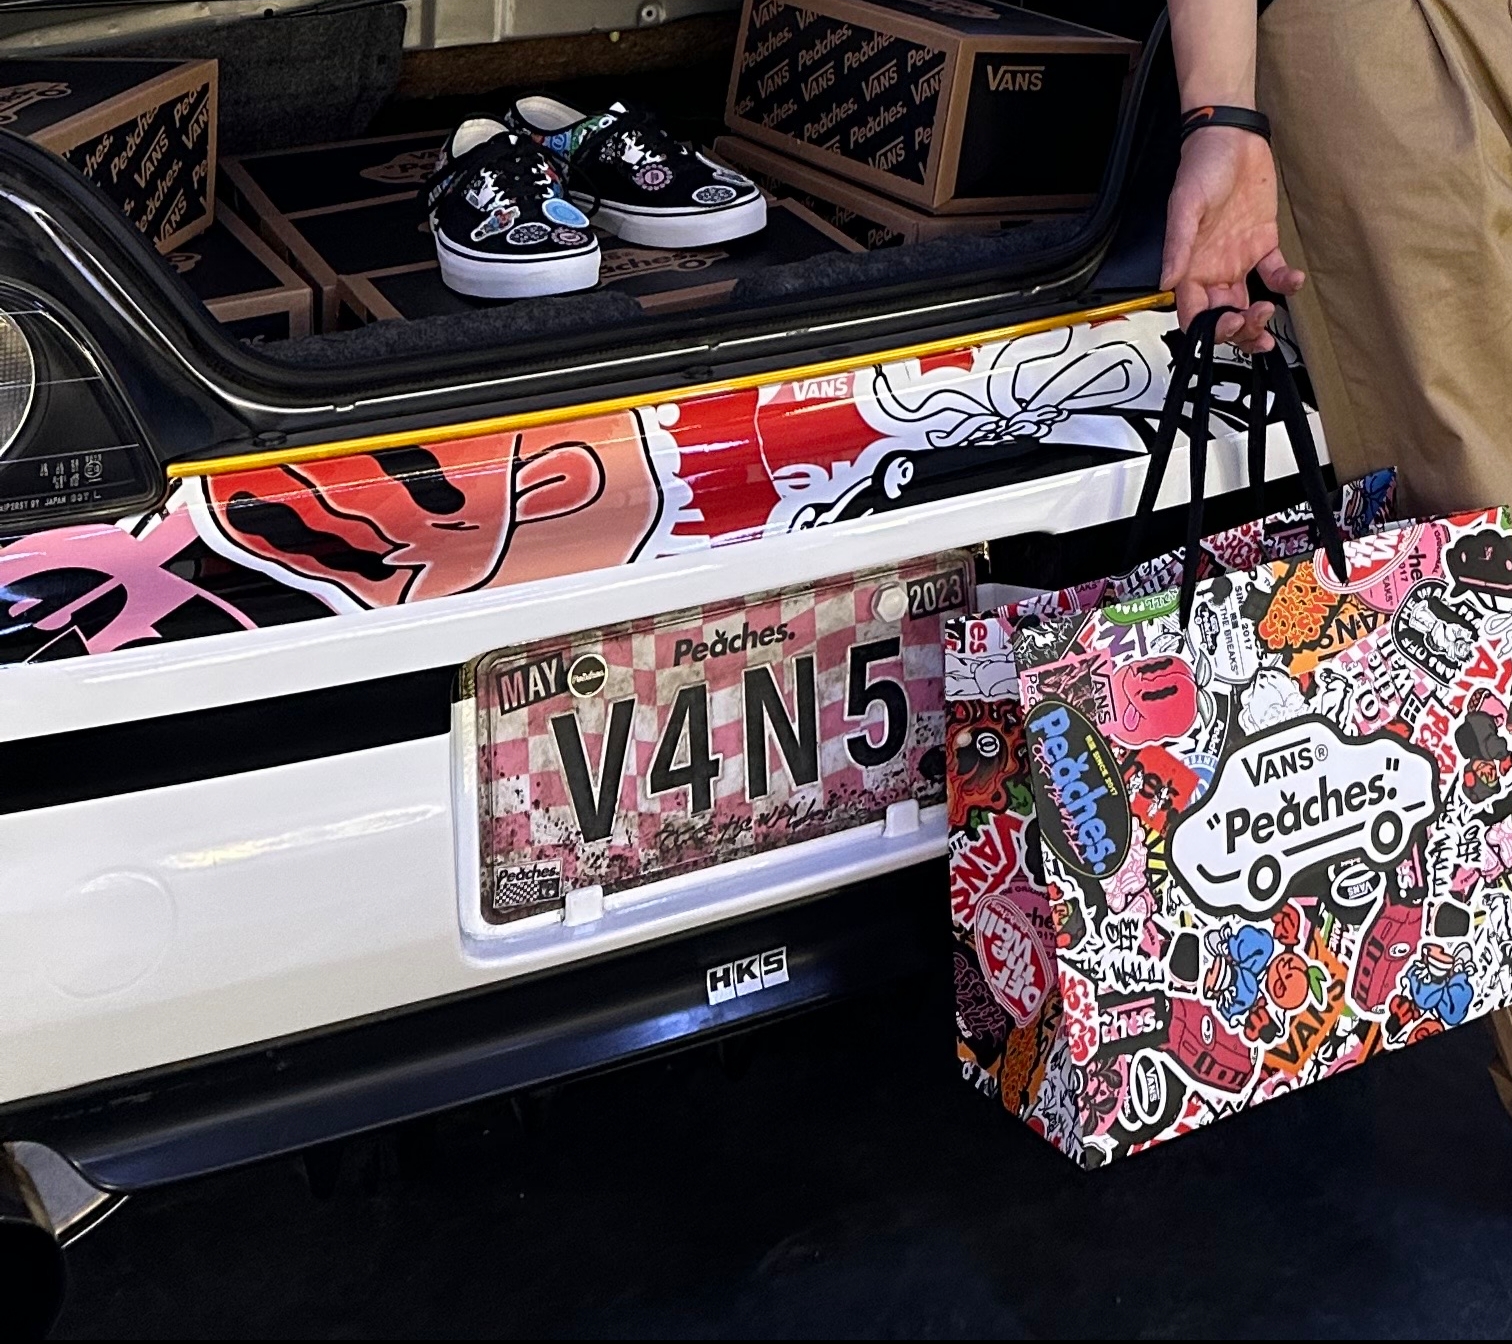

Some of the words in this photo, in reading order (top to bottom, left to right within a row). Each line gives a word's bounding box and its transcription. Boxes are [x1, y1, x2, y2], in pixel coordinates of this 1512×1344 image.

[757, 57, 791, 100] VANS
[800, 59, 836, 103] VANS
[861, 57, 899, 103] VANS
[985, 64, 1047, 92] VANS
[133, 124, 169, 189] VANS
[791, 374, 849, 401] VANS
[44, 496, 67, 506] JAPAN
[908, 574, 963, 616] 2023
[500, 657, 558, 711] MAY
[1090, 659, 1118, 725] VANS
[551, 637, 911, 843] V4N5
[708, 949, 785, 993] HKS
[990, 940, 1037, 985] the
[1145, 1067, 1160, 1103] VANS
